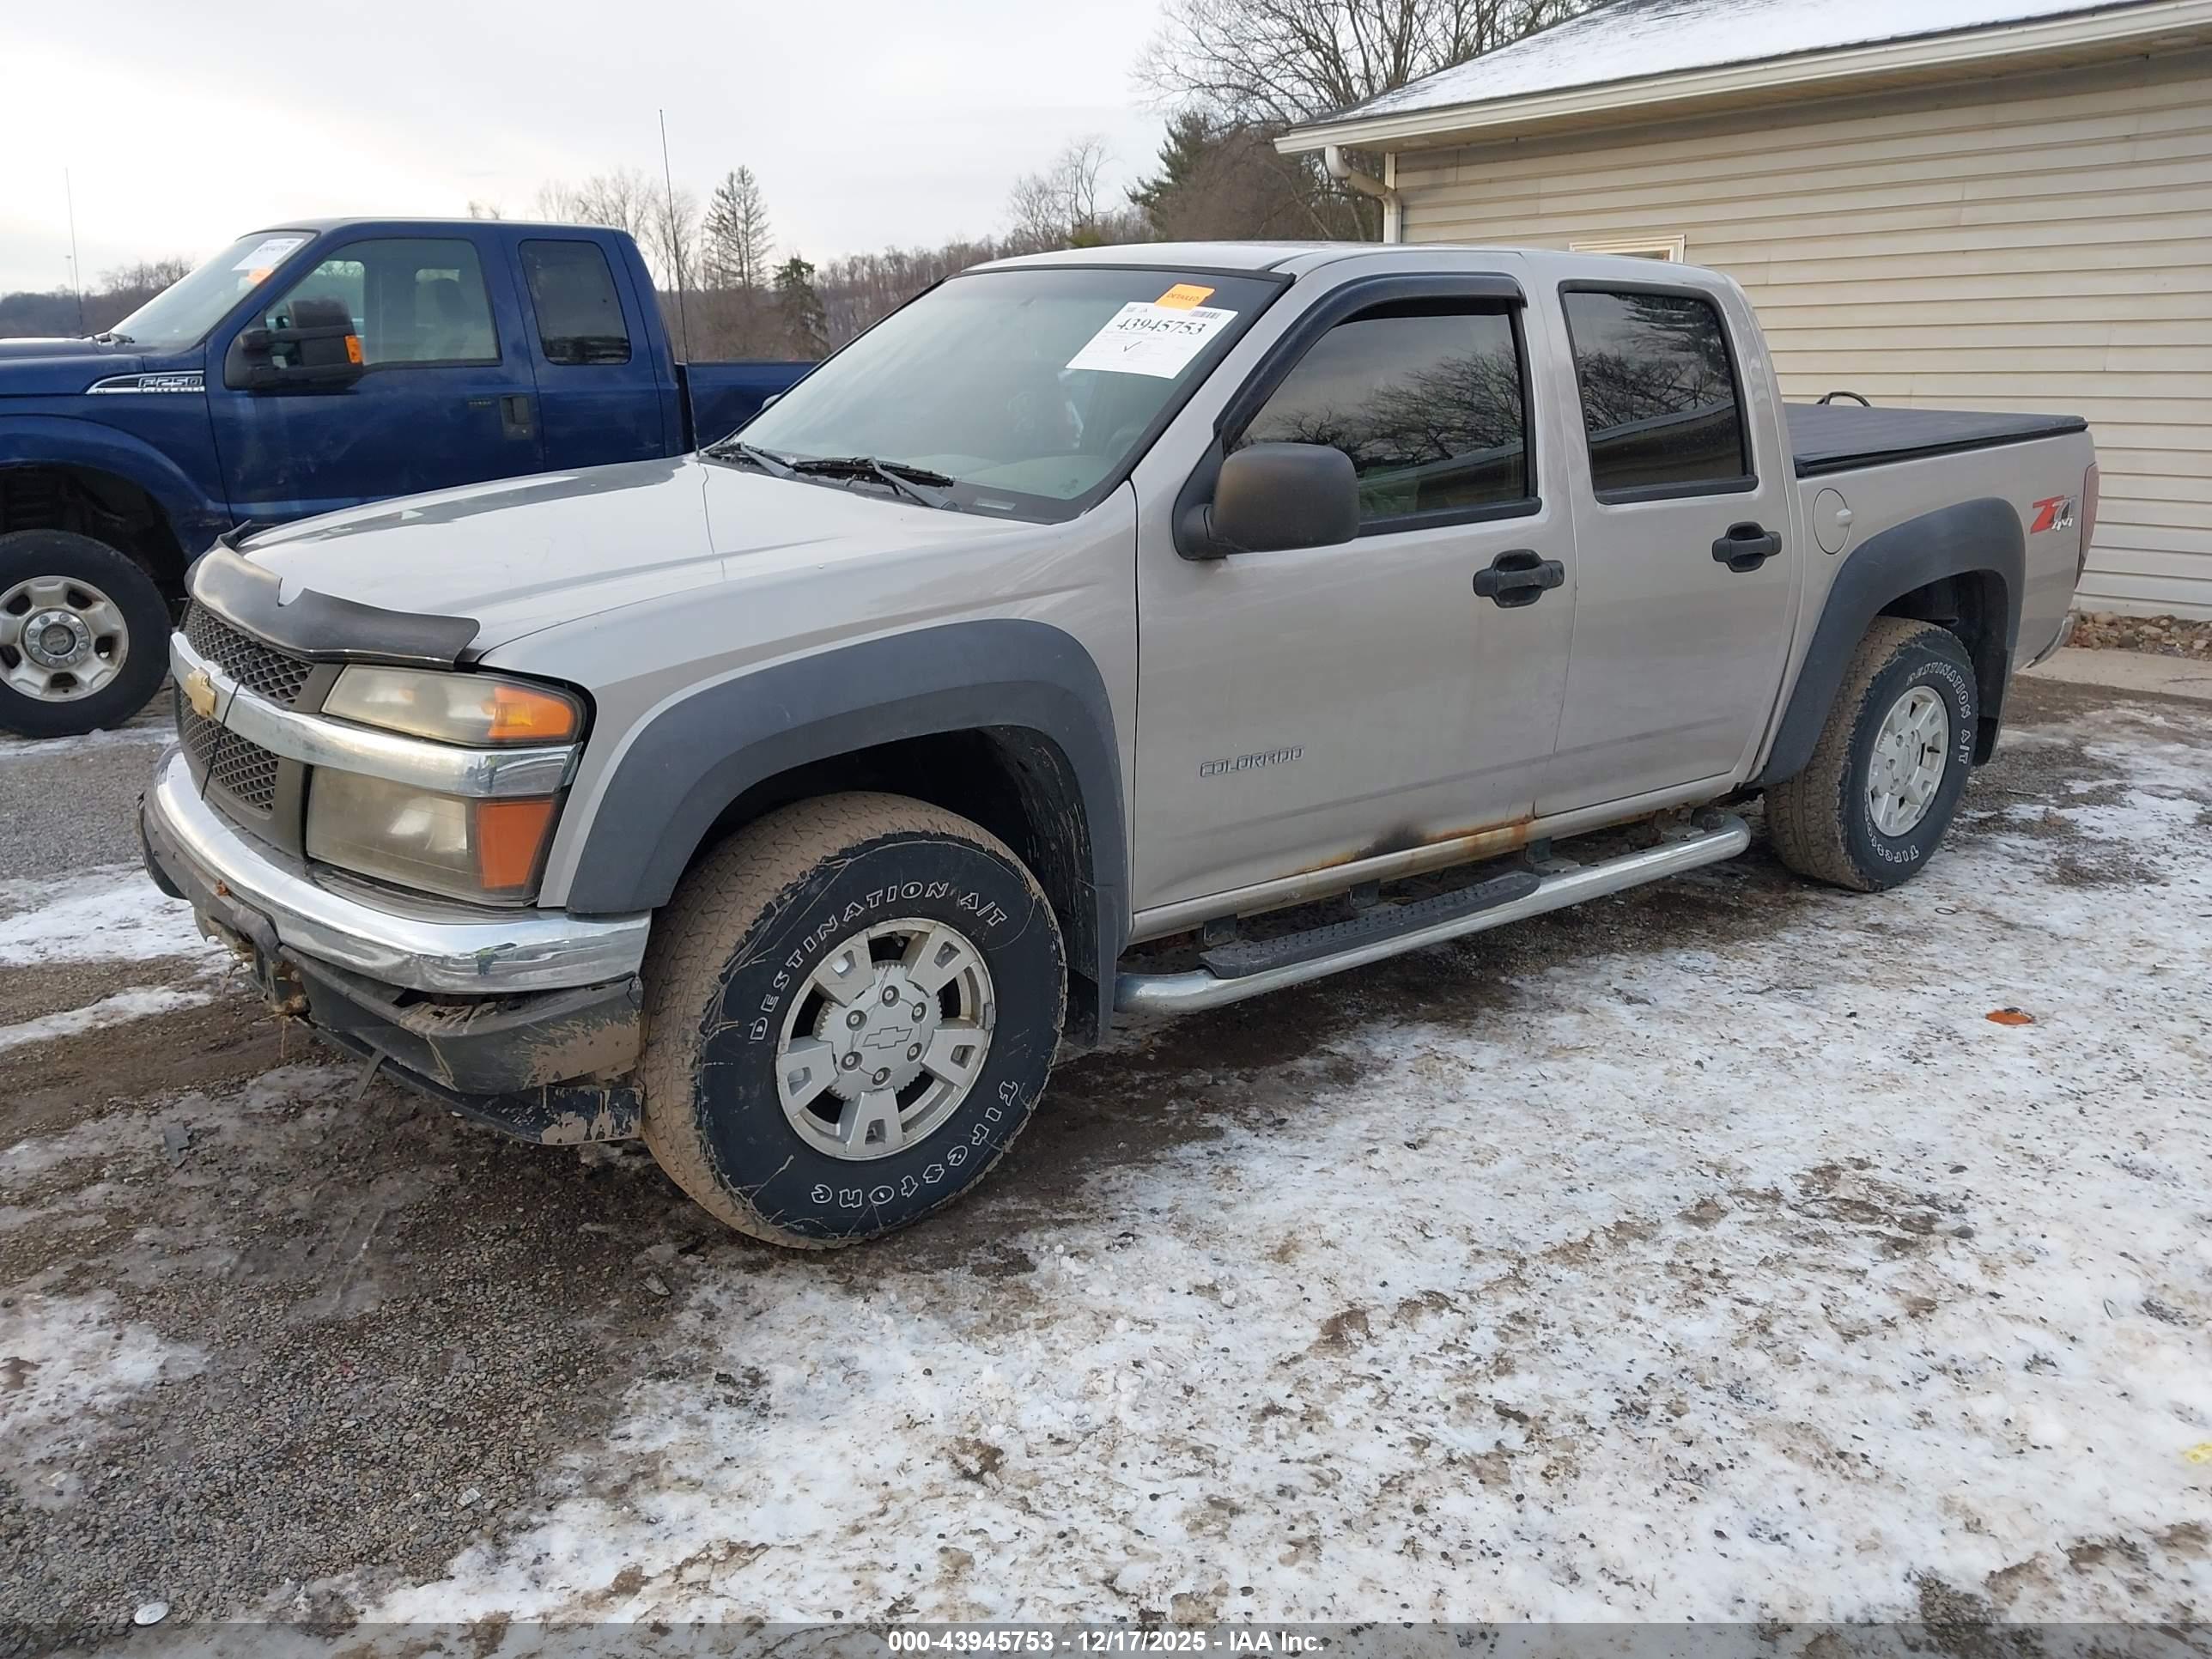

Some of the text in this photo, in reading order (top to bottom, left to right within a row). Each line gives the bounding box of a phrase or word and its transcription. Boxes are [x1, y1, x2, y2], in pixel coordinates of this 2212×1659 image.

[1116, 317, 1207, 336] 43945753
[1200, 745, 1305, 778] COLORADO
[749, 881, 1010, 1044] DESTINATION A/T
